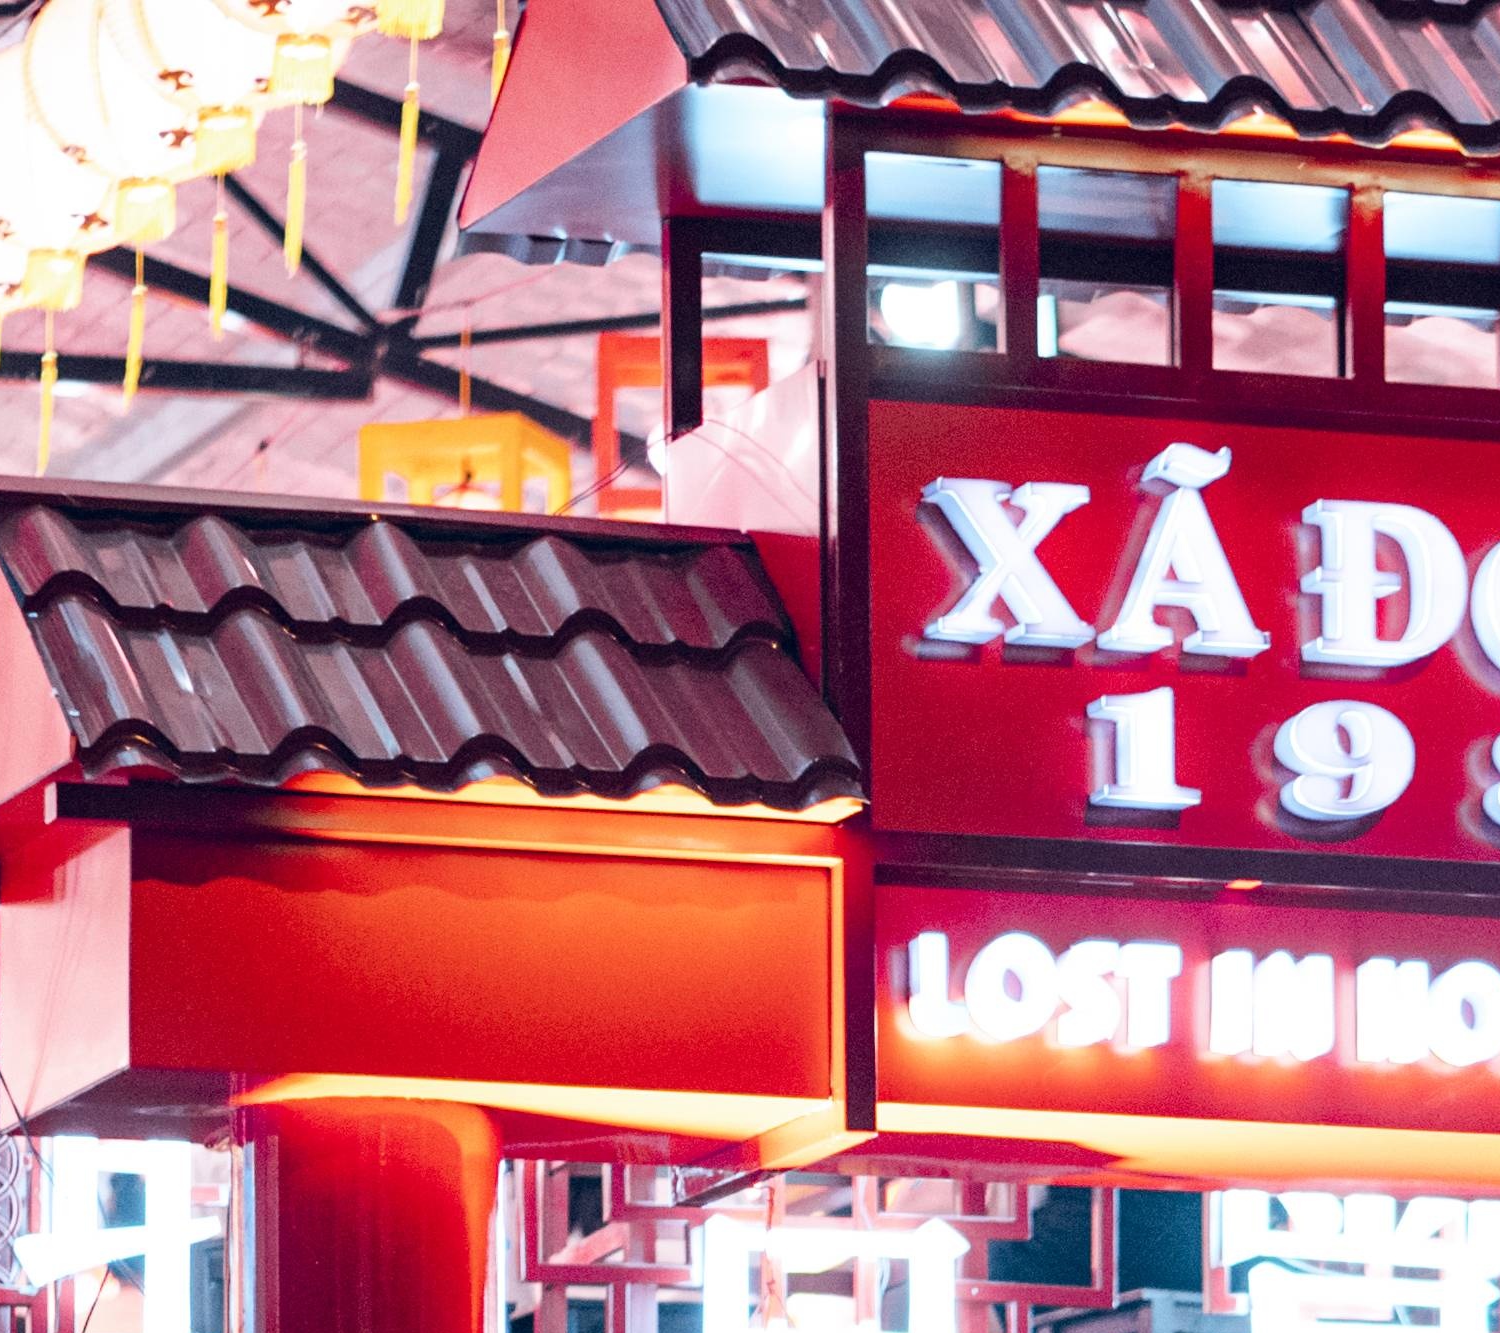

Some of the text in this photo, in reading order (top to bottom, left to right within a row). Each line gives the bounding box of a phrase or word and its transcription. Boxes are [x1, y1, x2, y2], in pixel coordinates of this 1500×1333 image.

[918, 442, 1271, 657] XÃ
[906, 930, 1184, 1049] LOST
[1208, 947, 1336, 1063] IN
